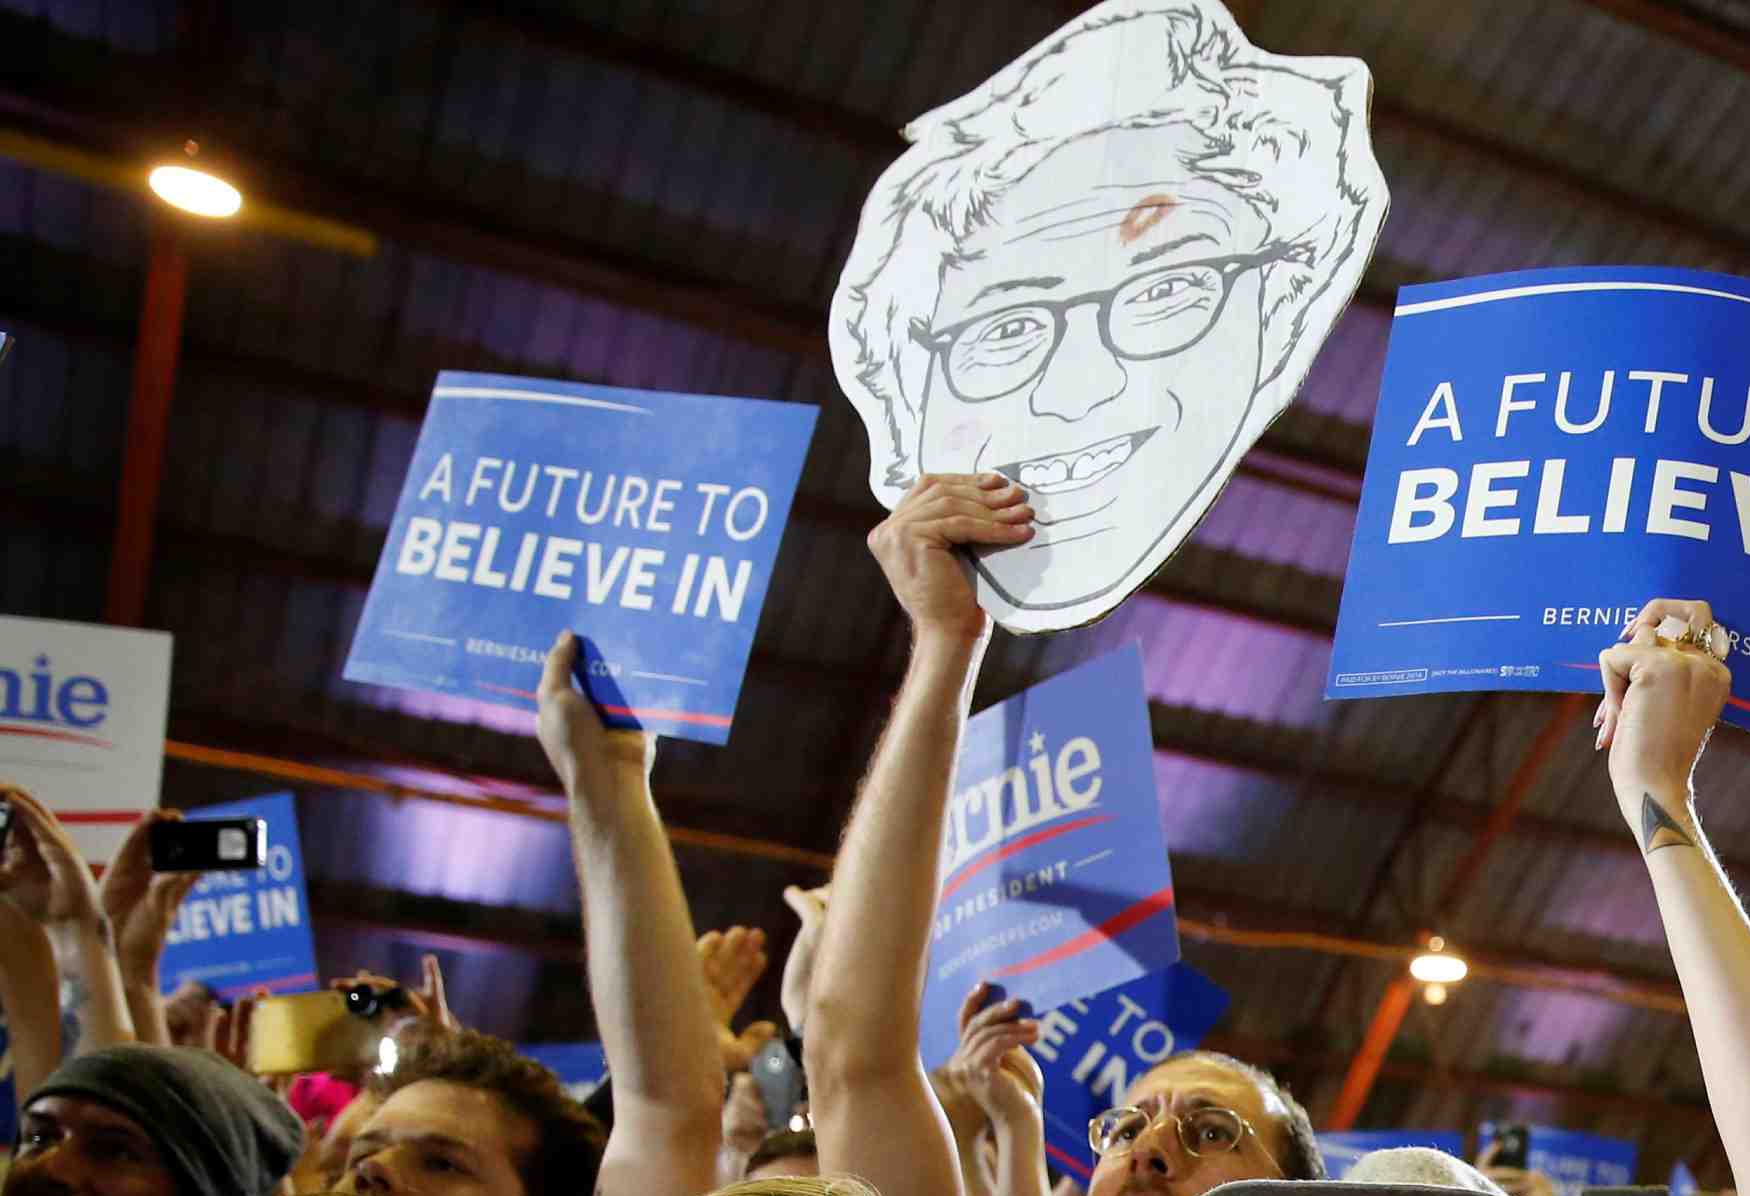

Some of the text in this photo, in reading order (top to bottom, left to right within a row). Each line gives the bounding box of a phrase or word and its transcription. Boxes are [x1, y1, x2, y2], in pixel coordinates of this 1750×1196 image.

[1406, 381, 1463, 446] A
[418, 453, 769, 541] A FUTURE TO
[396, 517, 754, 623] BELIEVE IN
[943, 732, 1102, 868] rnie
[165, 886, 300, 945] IEVE IN
[1108, 994, 1175, 1063] TO
